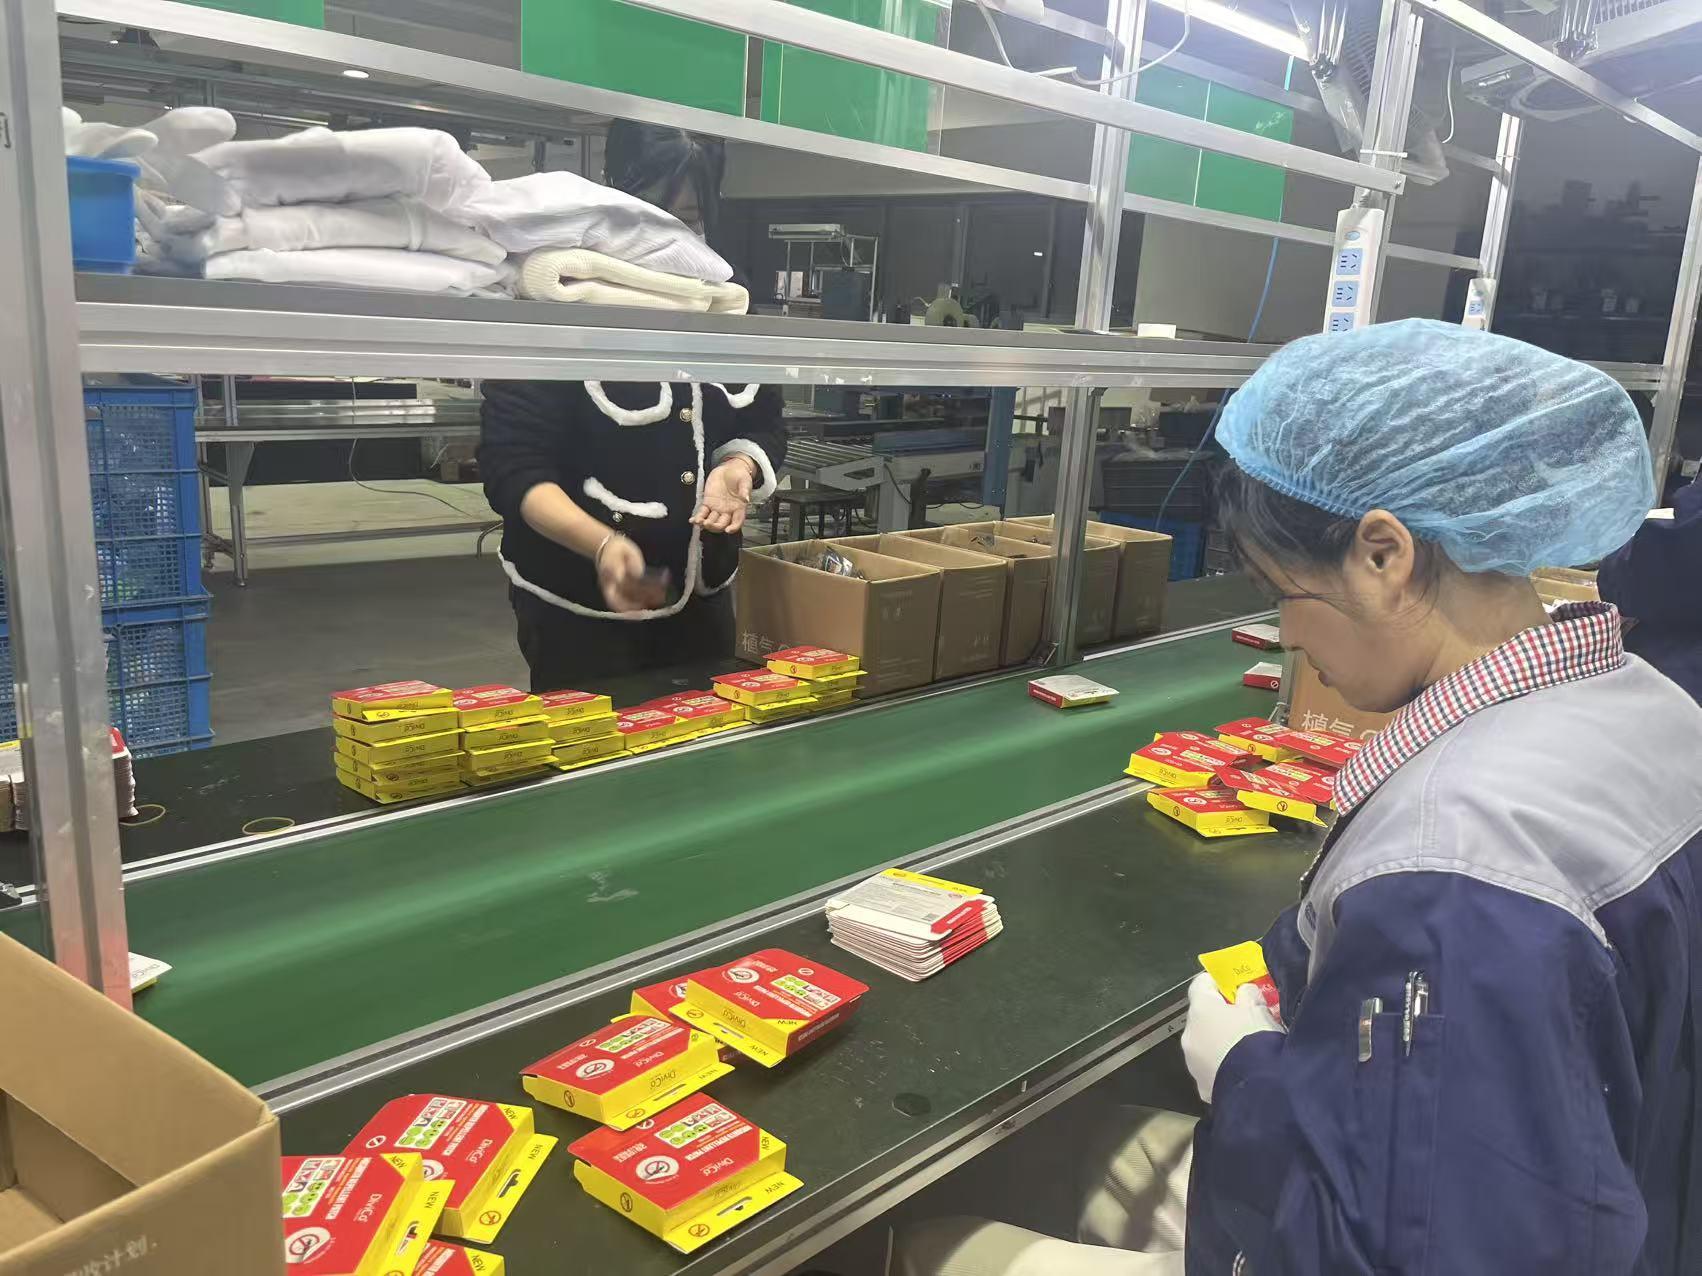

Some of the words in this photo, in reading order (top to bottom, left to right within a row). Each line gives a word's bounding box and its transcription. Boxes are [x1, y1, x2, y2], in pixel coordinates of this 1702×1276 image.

[650, 1070, 678, 1089] DiviCo
[530, 1144, 544, 1160] NEW
[390, 1155, 408, 1169] NEW
[702, 1156, 735, 1177] DiviCo
[765, 1181, 785, 1194] NEW
[425, 1191, 440, 1209] NEW
[471, 1254, 486, 1272] NEW
